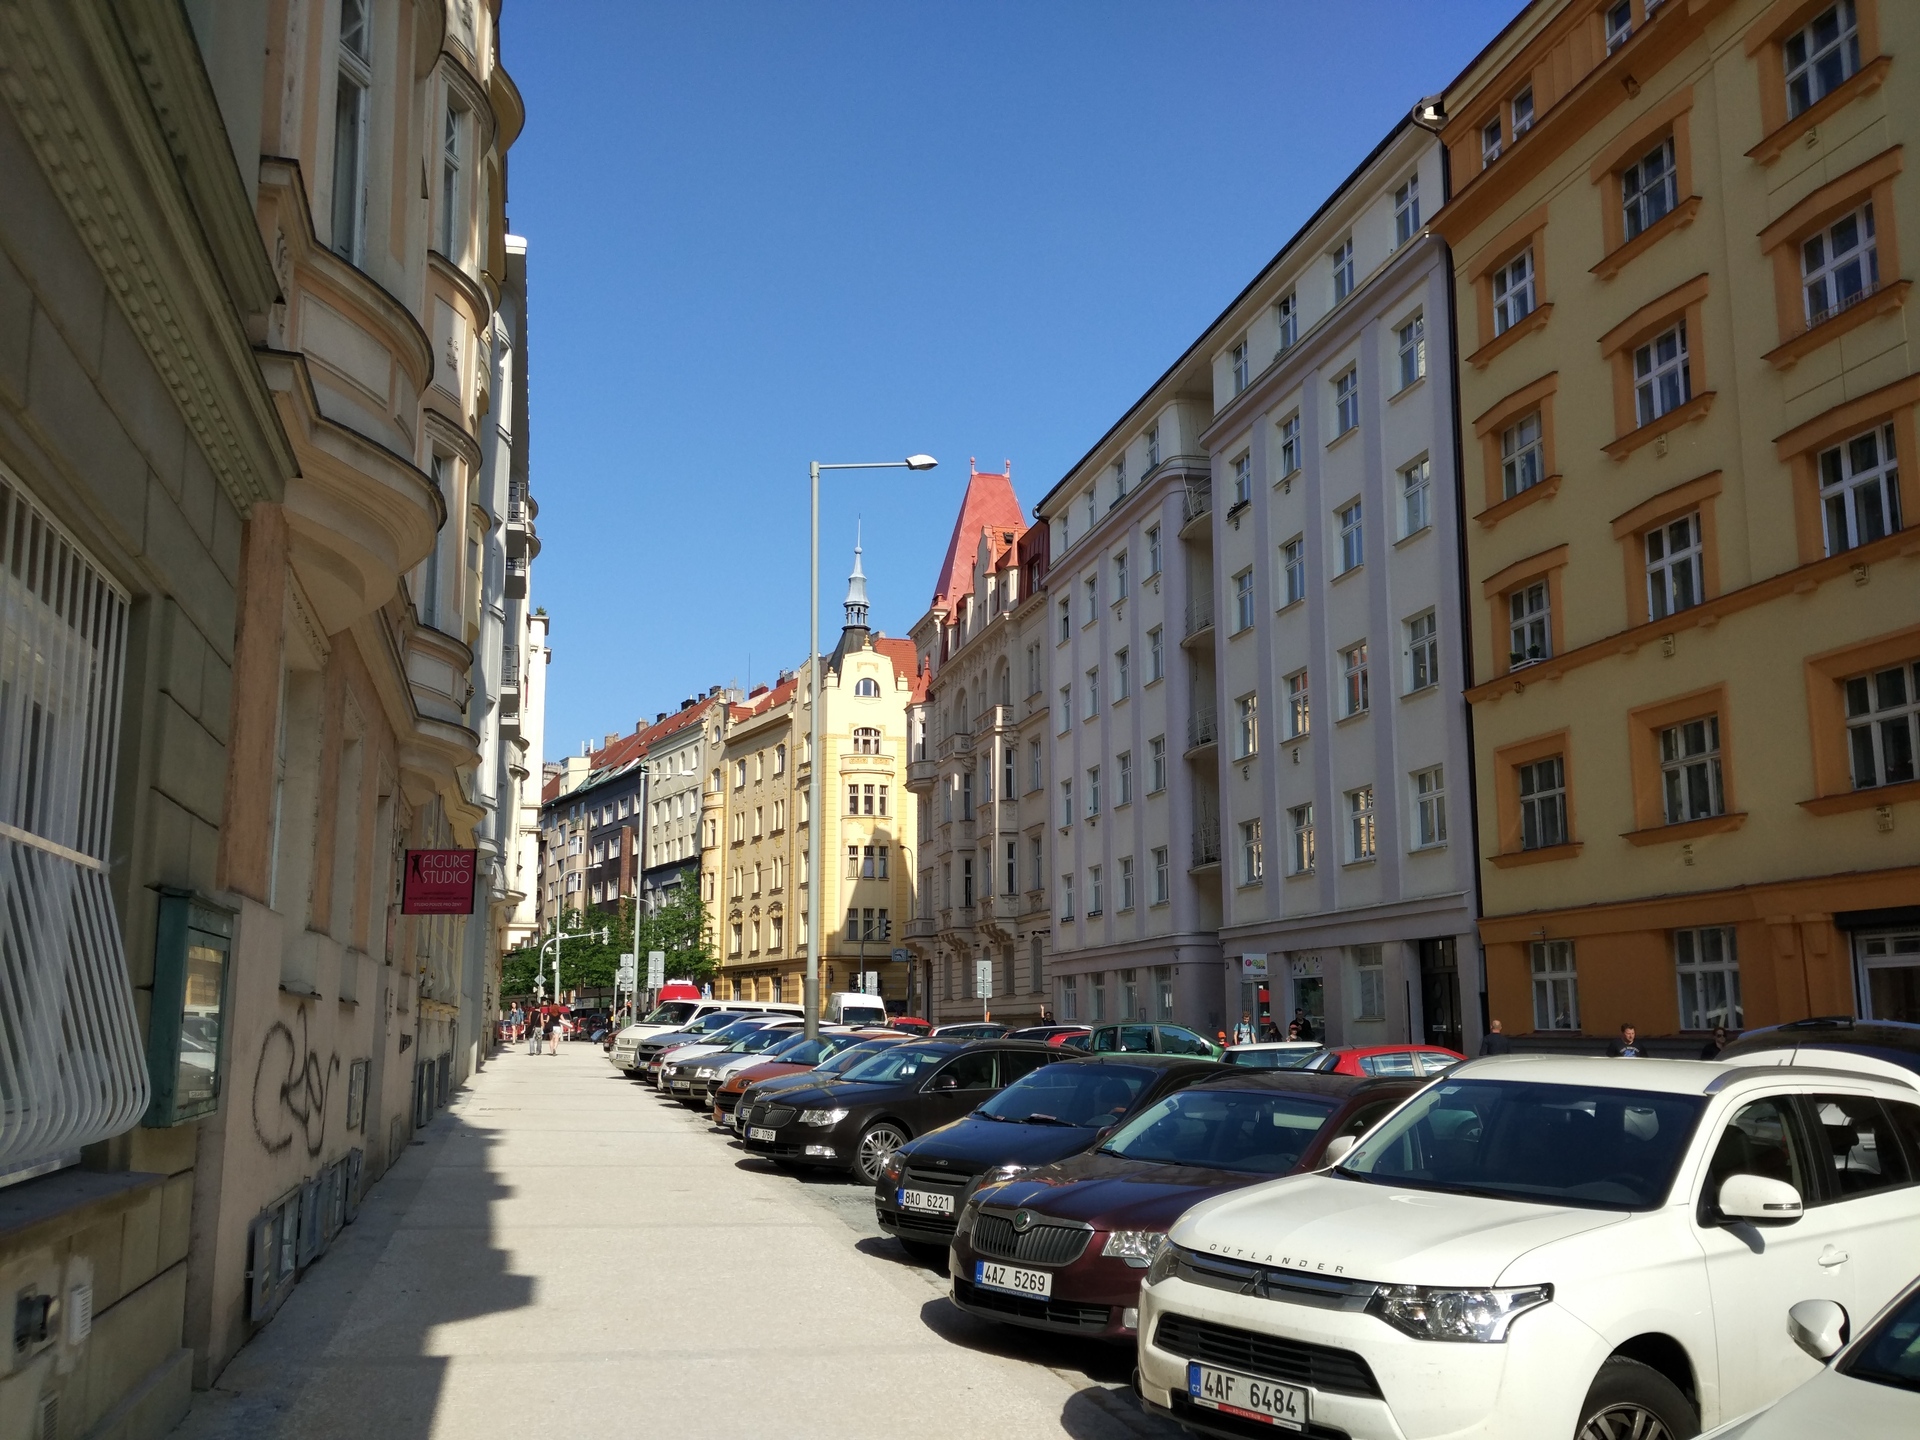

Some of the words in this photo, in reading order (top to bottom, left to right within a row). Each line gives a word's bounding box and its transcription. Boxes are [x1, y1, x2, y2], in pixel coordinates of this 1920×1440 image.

[423, 855, 471, 868] FIGURE
[423, 871, 469, 884] STUDIO
[926, 1194, 949, 1210] 6221
[1209, 1243, 1345, 1274] OUTLANDER
[984, 1264, 1006, 1285] 4AZ
[1014, 1270, 1046, 1292] 5269
[1191, 1384, 1201, 1393] CZ
[1204, 1371, 1236, 1401] 4AF
[1249, 1383, 1297, 1418] 6484
